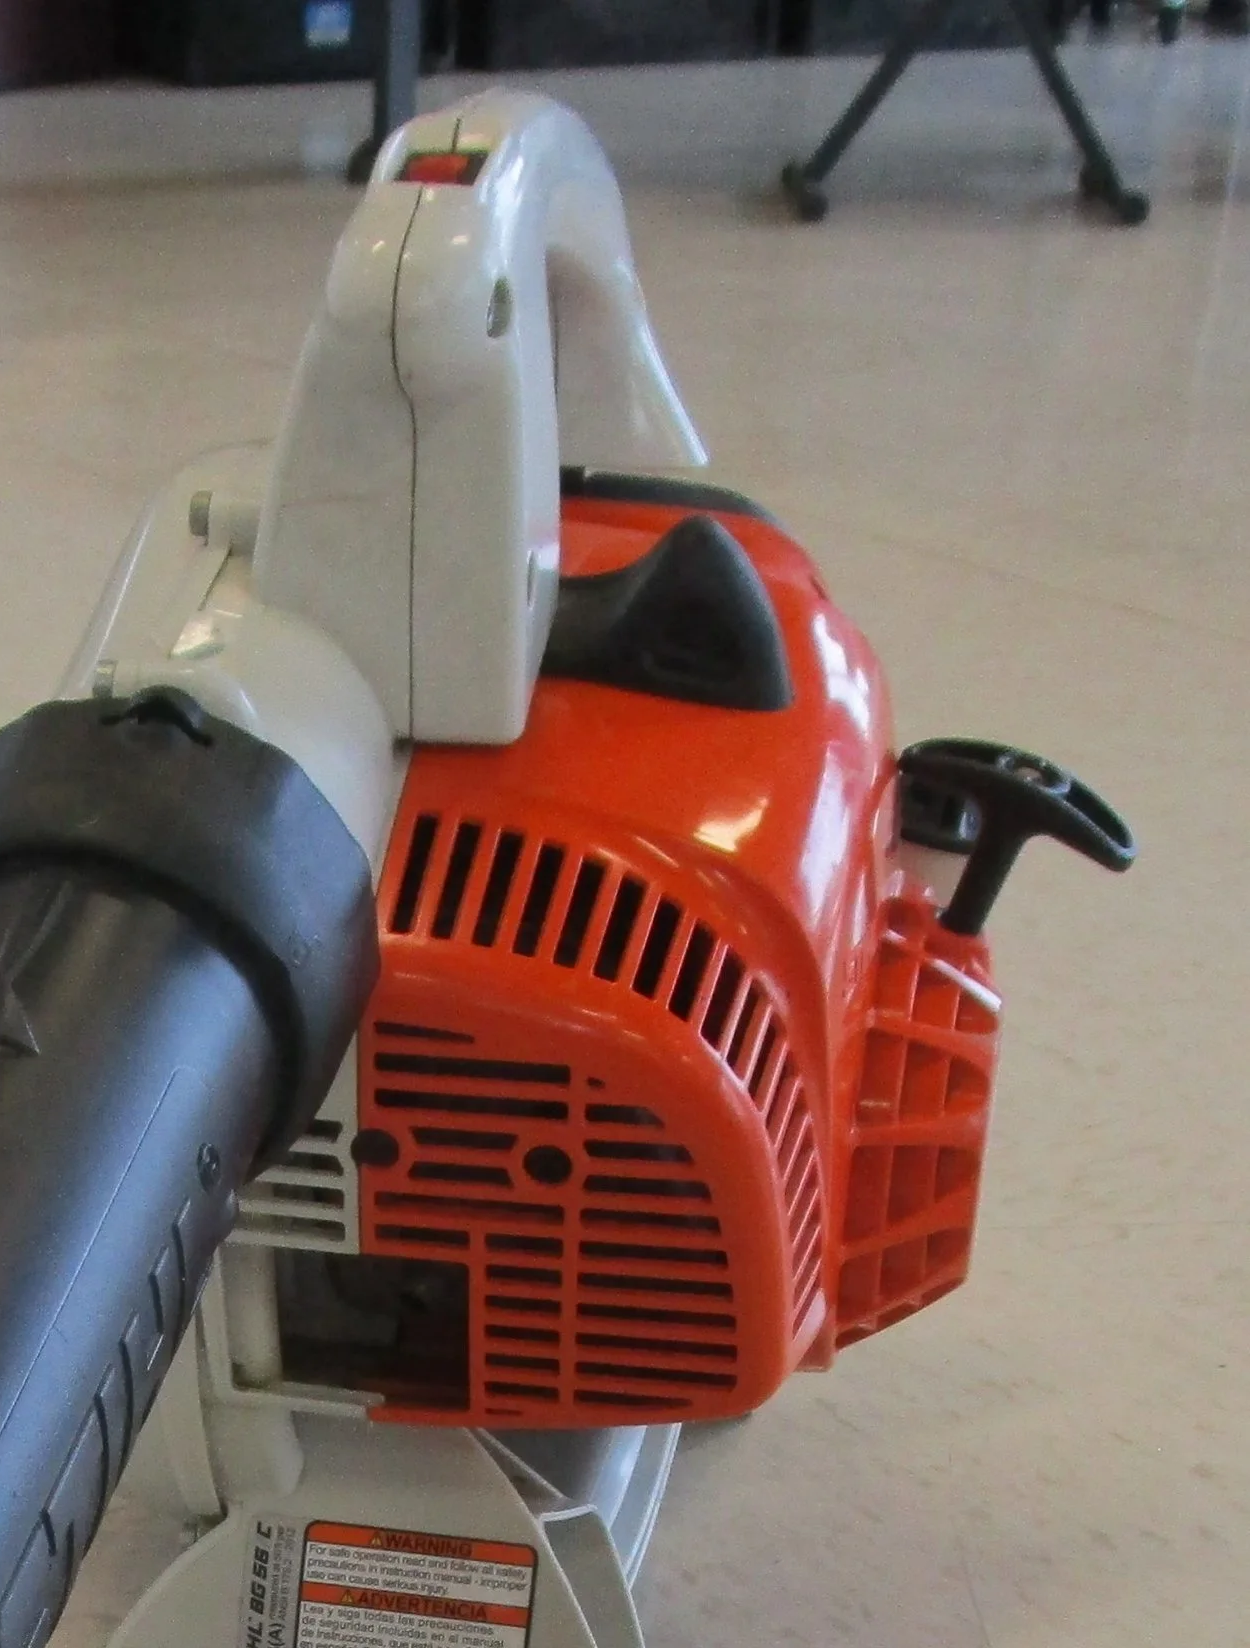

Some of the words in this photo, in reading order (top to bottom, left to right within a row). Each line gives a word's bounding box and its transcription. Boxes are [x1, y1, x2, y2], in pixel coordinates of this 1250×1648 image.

[257, 1521, 271, 1539] C
[386, 1533, 472, 1556] WARNING
[253, 1545, 269, 1580] 56
[307, 1558, 366, 1573] precautions
[369, 1565, 378, 1573] in
[380, 1566, 430, 1580] instruction
[433, 1573, 471, 1585] manual
[481, 1579, 528, 1592] improper
[310, 1544, 326, 1555] For
[330, 1547, 350, 1558] safe
[352, 1550, 400, 1564] operation
[402, 1556, 426, 1567] read
[428, 1559, 447, 1570] and
[450, 1561, 479, 1573] follow
[482, 1565, 494, 1575] all
[496, 1567, 527, 1581] safety
[307, 1571, 326, 1580] use
[328, 1573, 347, 1582] can
[349, 1576, 380, 1586] cause
[382, 1579, 418, 1591] serious
[250, 1581, 266, 1614] BG
[357, 1591, 488, 1619] ADVERTENCIA
[302, 1615, 316, 1626] de
[319, 1618, 375, 1633] seguridad
[378, 1624, 427, 1639] incluidas
[431, 1632, 445, 1641] en
[462, 1637, 504, 1648] manual
[303, 1604, 324, 1615] Lea
[327, 1608, 334, 1617] y
[338, 1608, 360, 1620] siga
[364, 1610, 395, 1623] todas
[418, 1618, 495, 1636] precauciones
[300, 1641, 313, 1648] en
[301, 1628, 315, 1638] de
[317, 1629, 386, 1648] instrucciones,
